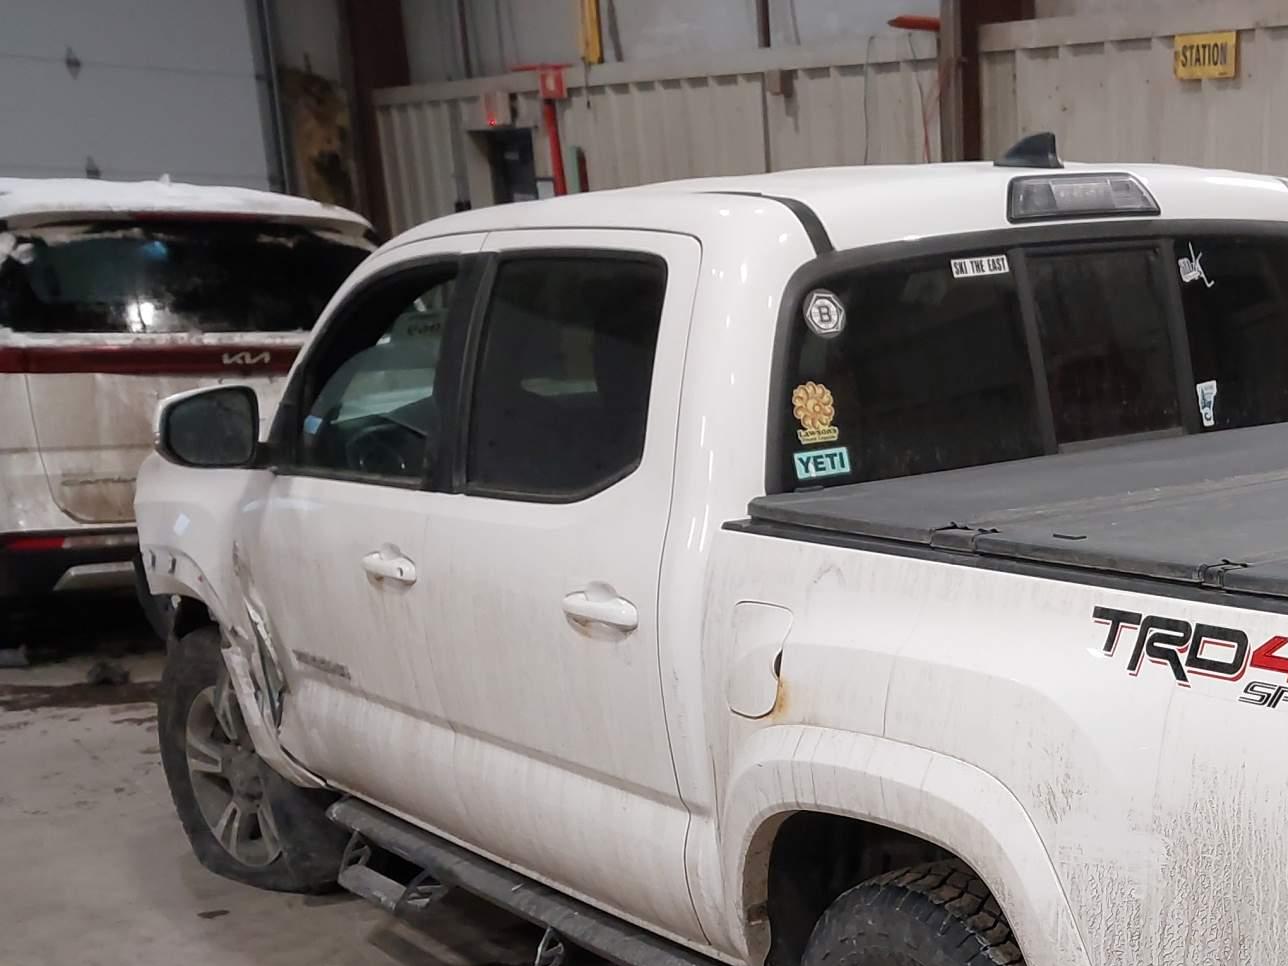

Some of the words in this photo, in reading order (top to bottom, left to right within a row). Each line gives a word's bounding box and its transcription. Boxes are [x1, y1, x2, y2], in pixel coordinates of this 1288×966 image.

[1181, 41, 1228, 67] STATION
[953, 261, 968, 275] SKI
[970, 259, 985, 273] THE
[987, 257, 1006, 271] EAST
[818, 305, 832, 323] B
[797, 452, 846, 473] YETI
[1092, 606, 1250, 688] TRD
